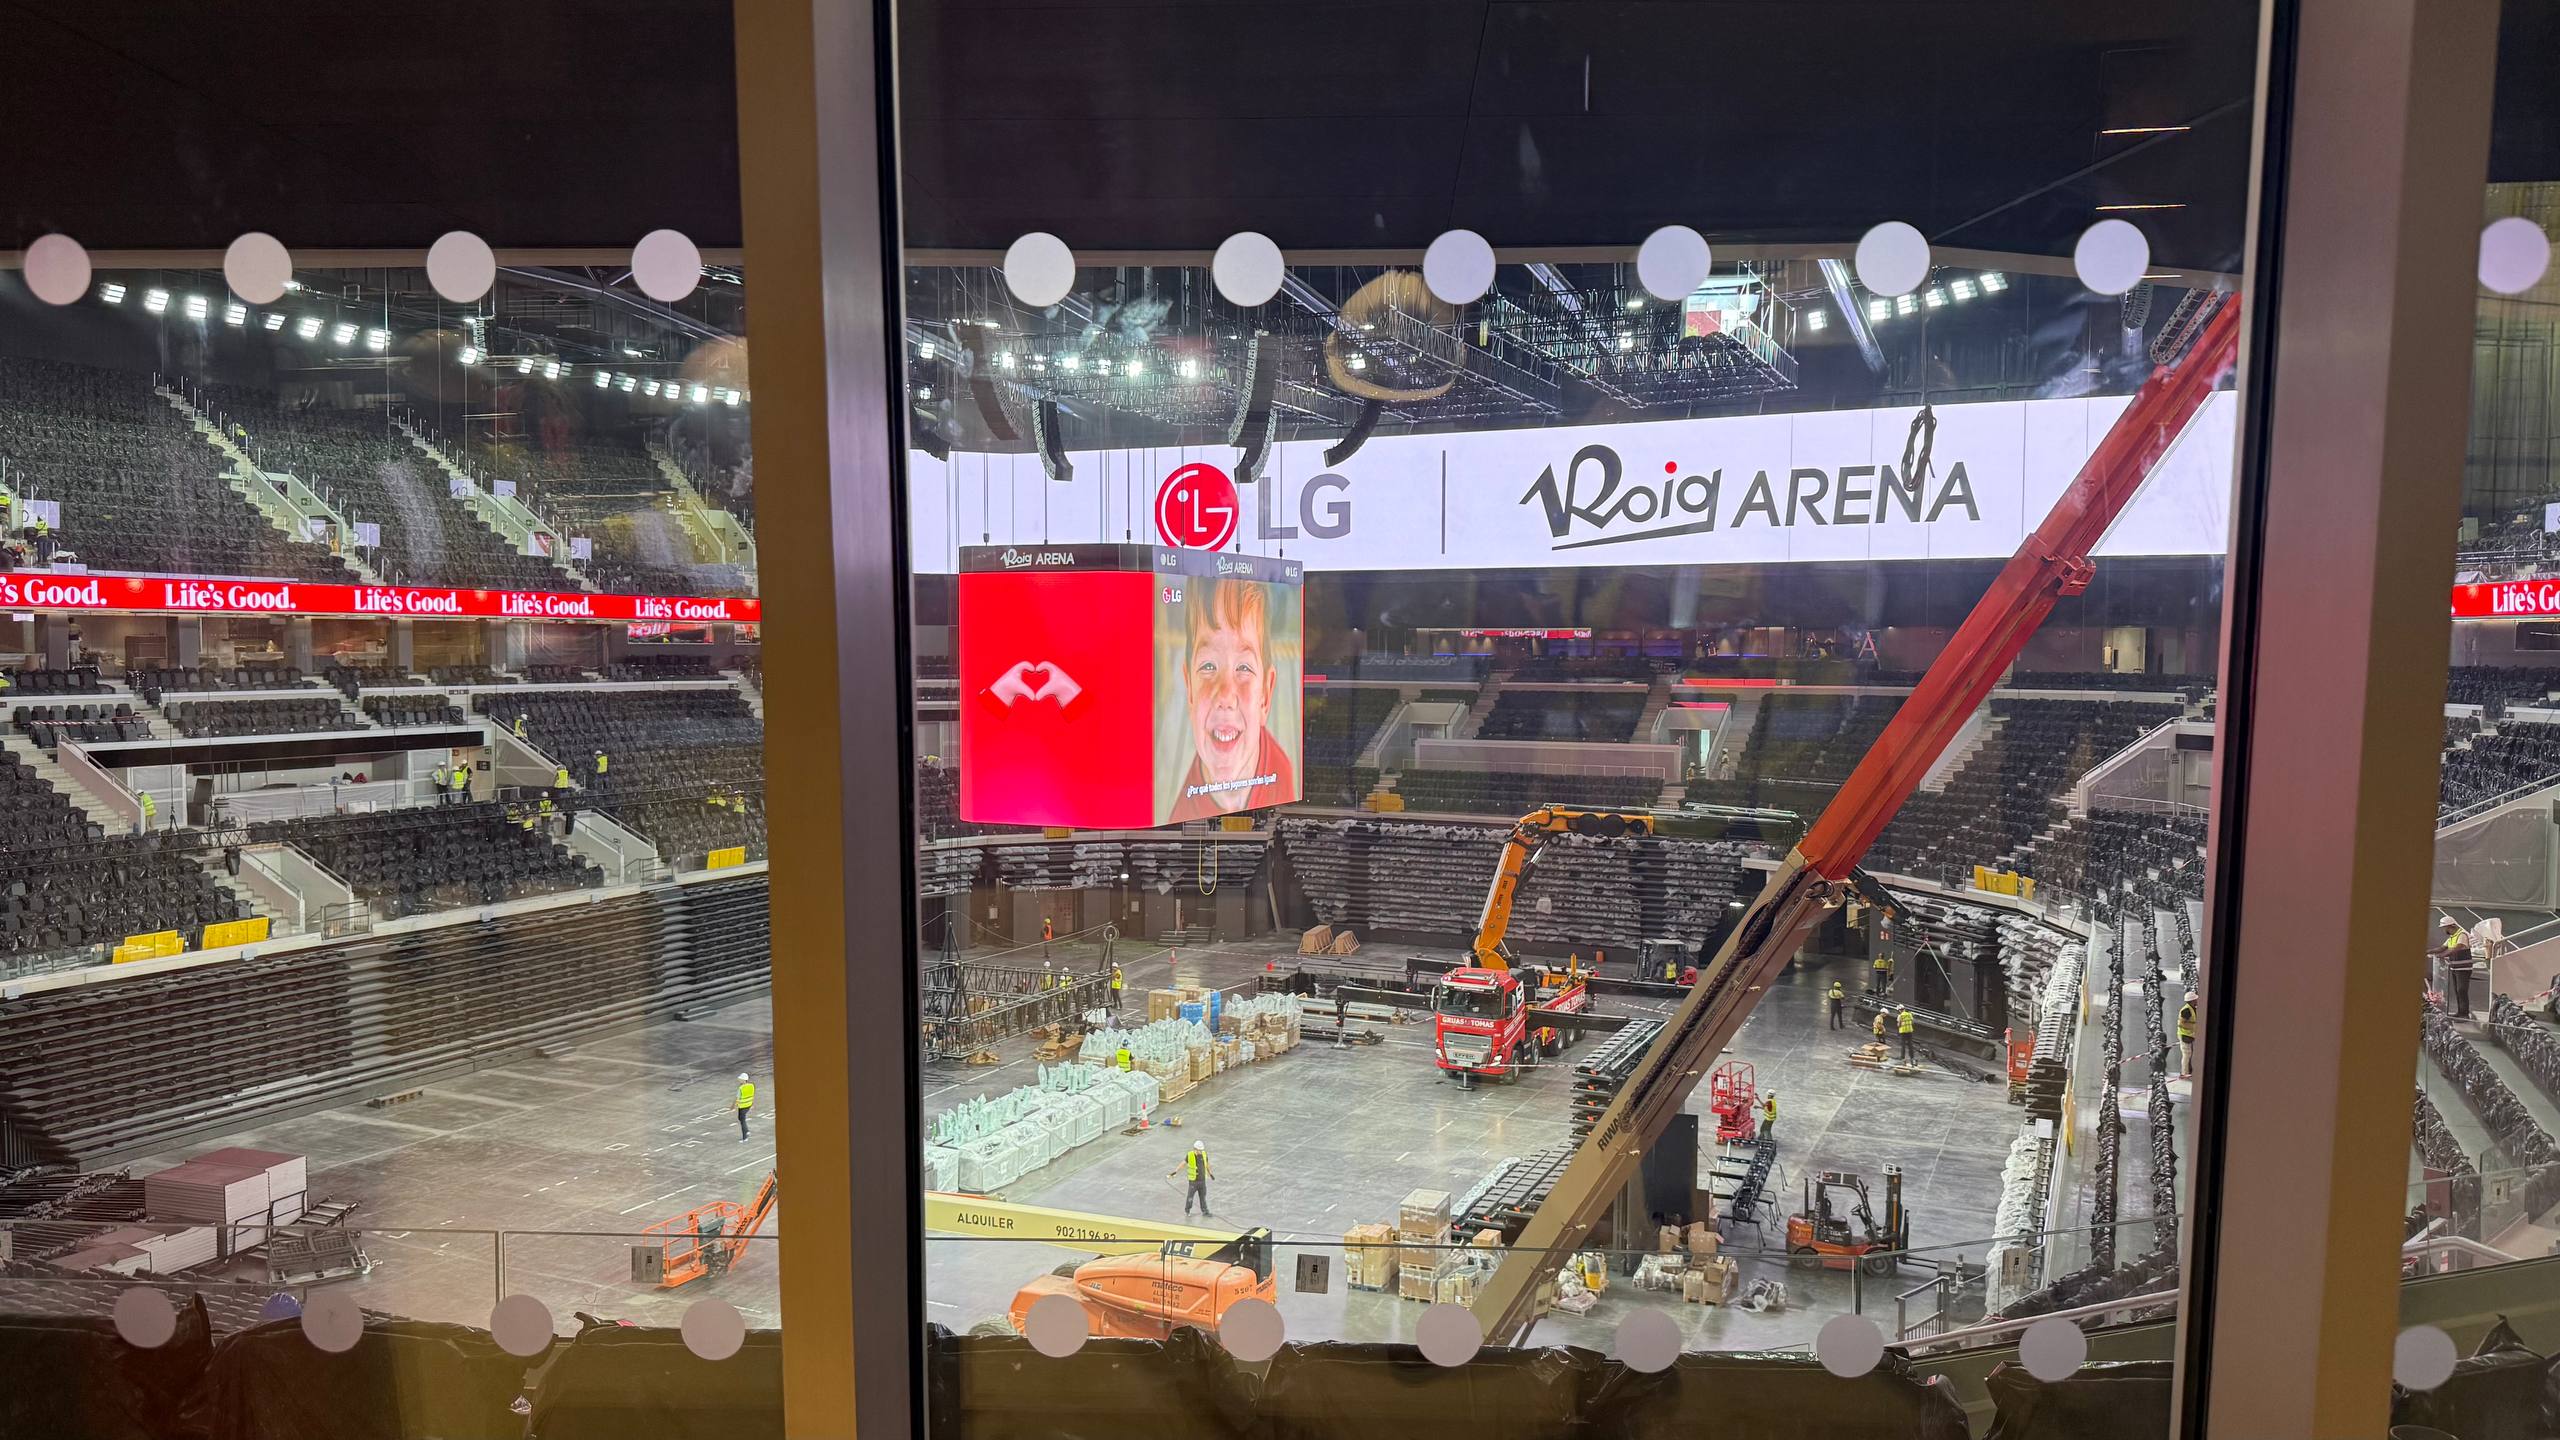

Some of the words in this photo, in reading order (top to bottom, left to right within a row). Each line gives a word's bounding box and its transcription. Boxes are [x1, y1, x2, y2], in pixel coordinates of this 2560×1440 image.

[1258, 473, 1351, 540] LG
[1520, 444, 1722, 550] Roig
[1730, 461, 1981, 528] ARENA
[1000, 548, 1032, 569] Roig
[1035, 552, 1075, 565] ARENA
[1233, 562, 1254, 575] ARENA
[0, 577, 19, 604] 's
[24, 579, 107, 605] Good.
[165, 583, 223, 608] Life's
[228, 585, 297, 609] Good.
[354, 589, 402, 612] Life's
[406, 591, 462, 613] Good.
[2493, 583, 2536, 612] Life's
[501, 594, 543, 615] Life's
[545, 596, 594, 616] Good.
[635, 598, 672, 618] Life's
[674, 600, 731, 619] Good.
[1442, 1016, 1465, 1025] GRUAS
[1597, 1115, 1621, 1152] RIWA
[957, 1212, 1014, 1230] ALQUILER
[1056, 1225, 1075, 1238] 902
[1152, 1280, 1184, 1293] mateco
